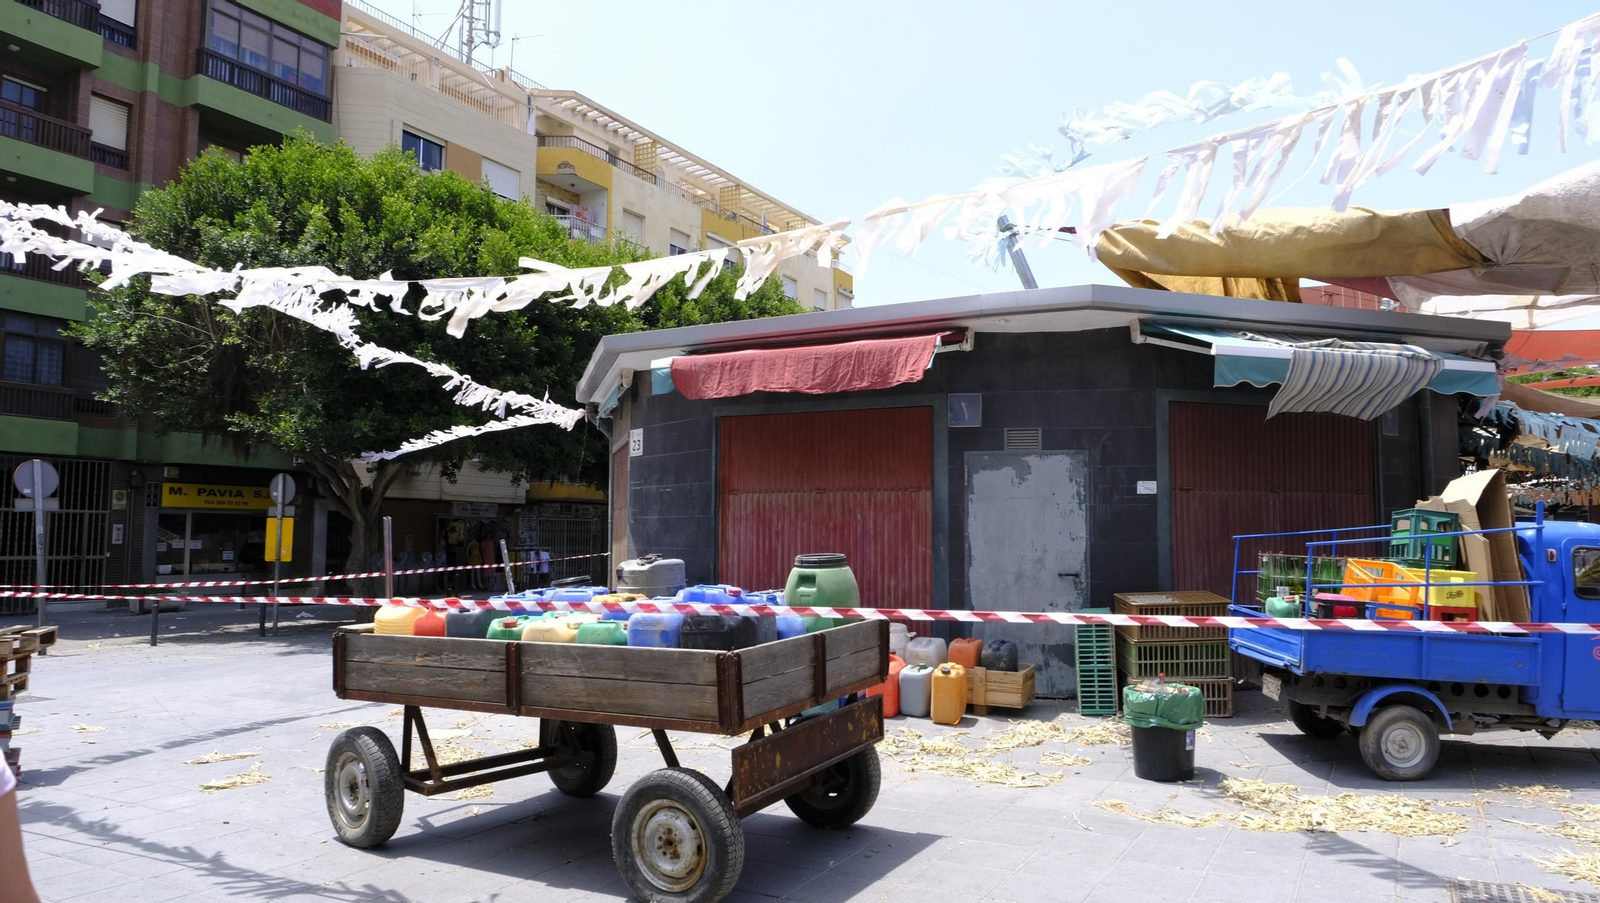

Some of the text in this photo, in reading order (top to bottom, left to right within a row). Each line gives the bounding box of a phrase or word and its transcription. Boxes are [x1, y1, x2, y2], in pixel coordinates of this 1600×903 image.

[632, 439, 641, 451] 23
[169, 486, 187, 496] M.
[197, 488, 244, 498] PAVIA
